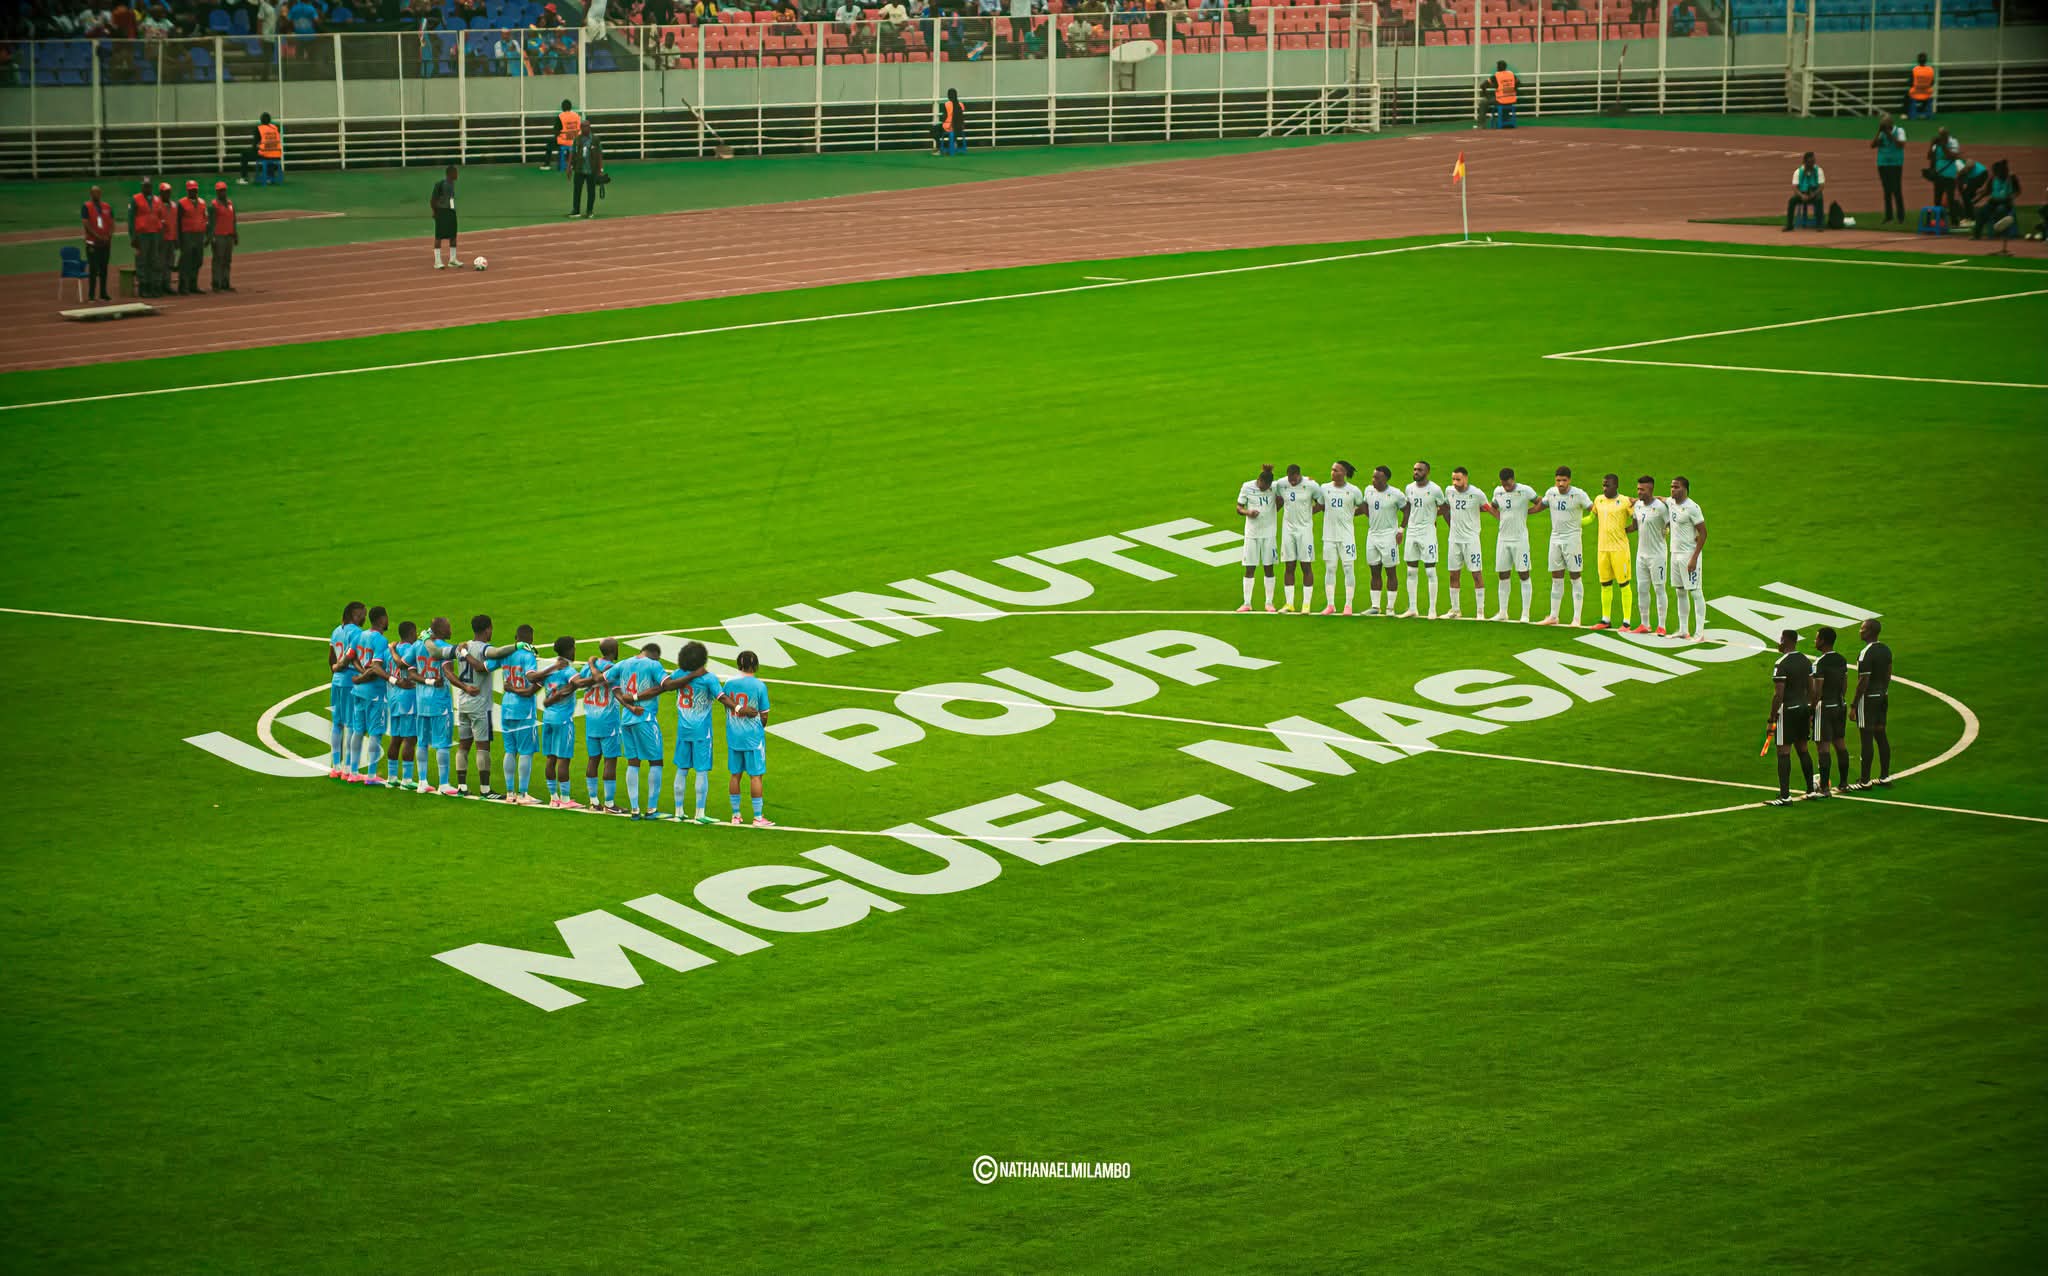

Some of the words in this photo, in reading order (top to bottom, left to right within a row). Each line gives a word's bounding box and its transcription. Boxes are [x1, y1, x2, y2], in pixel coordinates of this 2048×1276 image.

[1331, 498, 1343, 508] 20
[1374, 500, 1380, 510] 8
[1413, 498, 1423, 508] 21
[1455, 500, 1466, 510] 22
[1505, 499, 1512, 509] 3
[1557, 501, 1567, 511] 16
[1470, 553, 1481, 564] 22
[679, 683, 694, 709] 8
